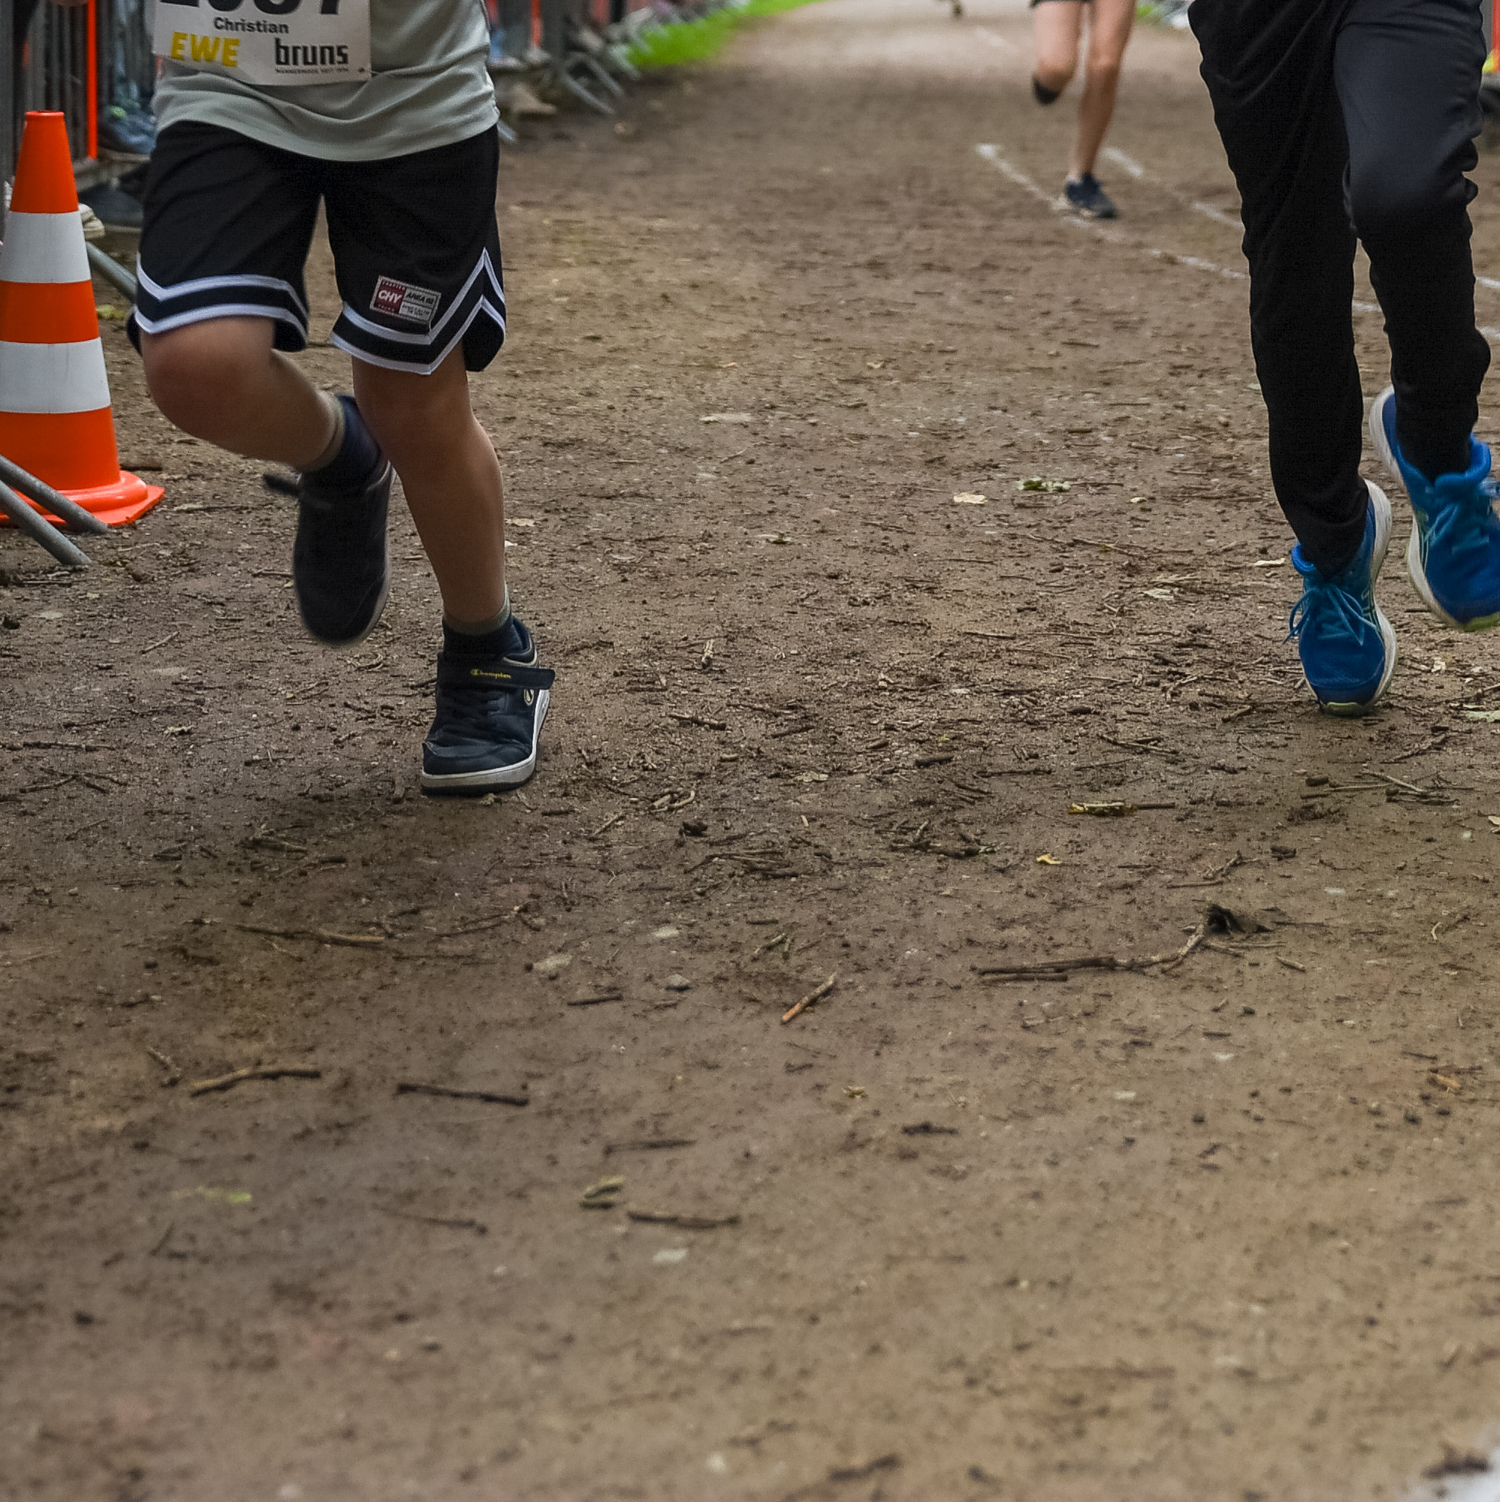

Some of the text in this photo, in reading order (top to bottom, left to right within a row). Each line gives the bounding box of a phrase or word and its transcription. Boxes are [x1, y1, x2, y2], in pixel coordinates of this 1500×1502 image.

[213, 16, 290, 34] Christian
[170, 31, 241, 67] EWE
[274, 37, 349, 66] bruns
[378, 289, 403, 303] CHY
